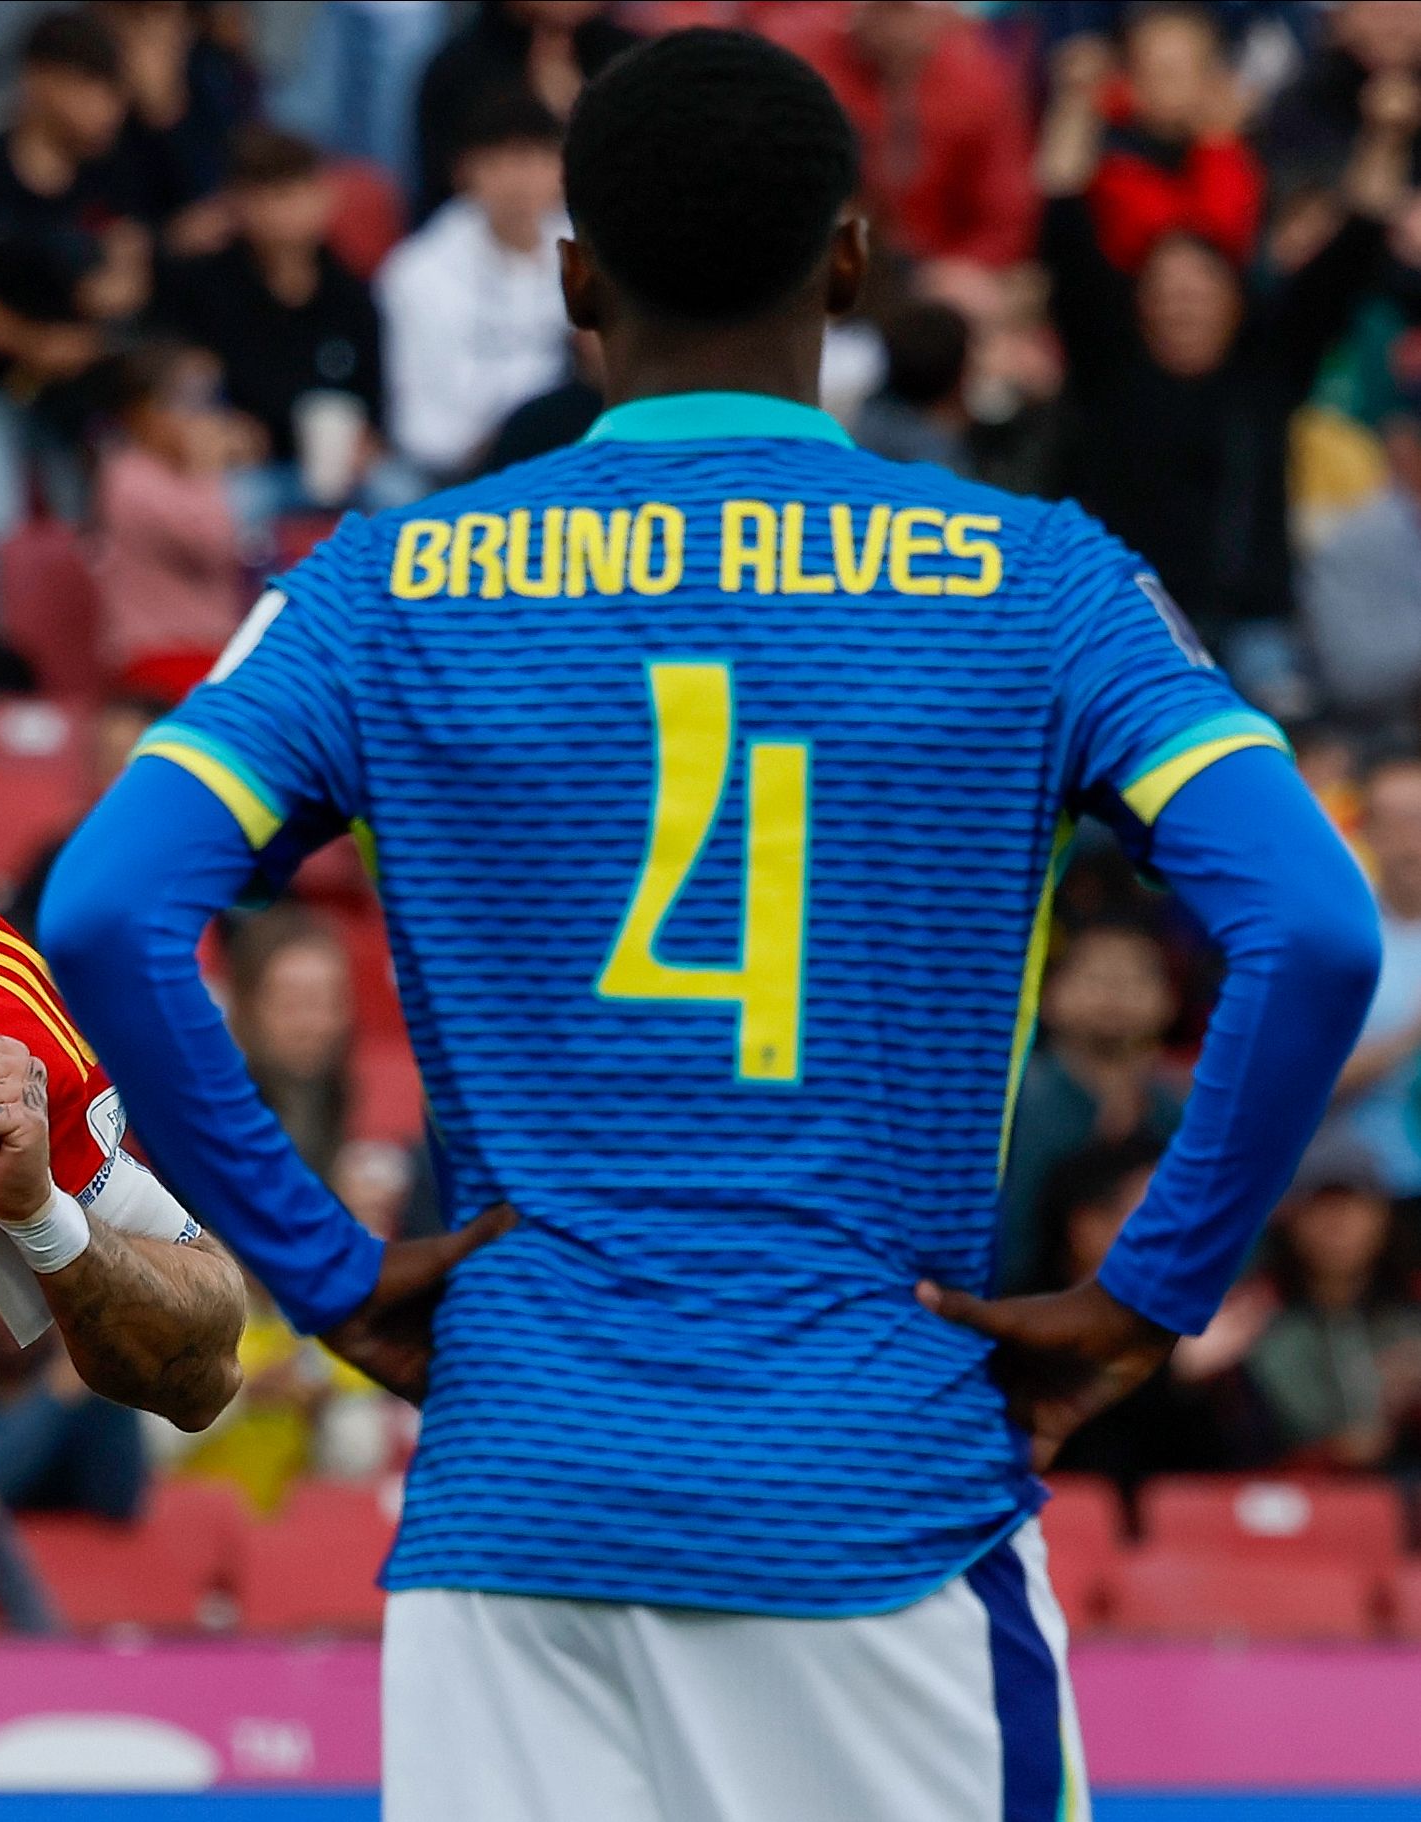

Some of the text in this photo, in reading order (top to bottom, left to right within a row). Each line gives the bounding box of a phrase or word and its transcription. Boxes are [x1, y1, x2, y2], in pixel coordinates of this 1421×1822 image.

[392, 500, 1003, 598] BRUNO ALVES
[596, 660, 812, 1082] 4
